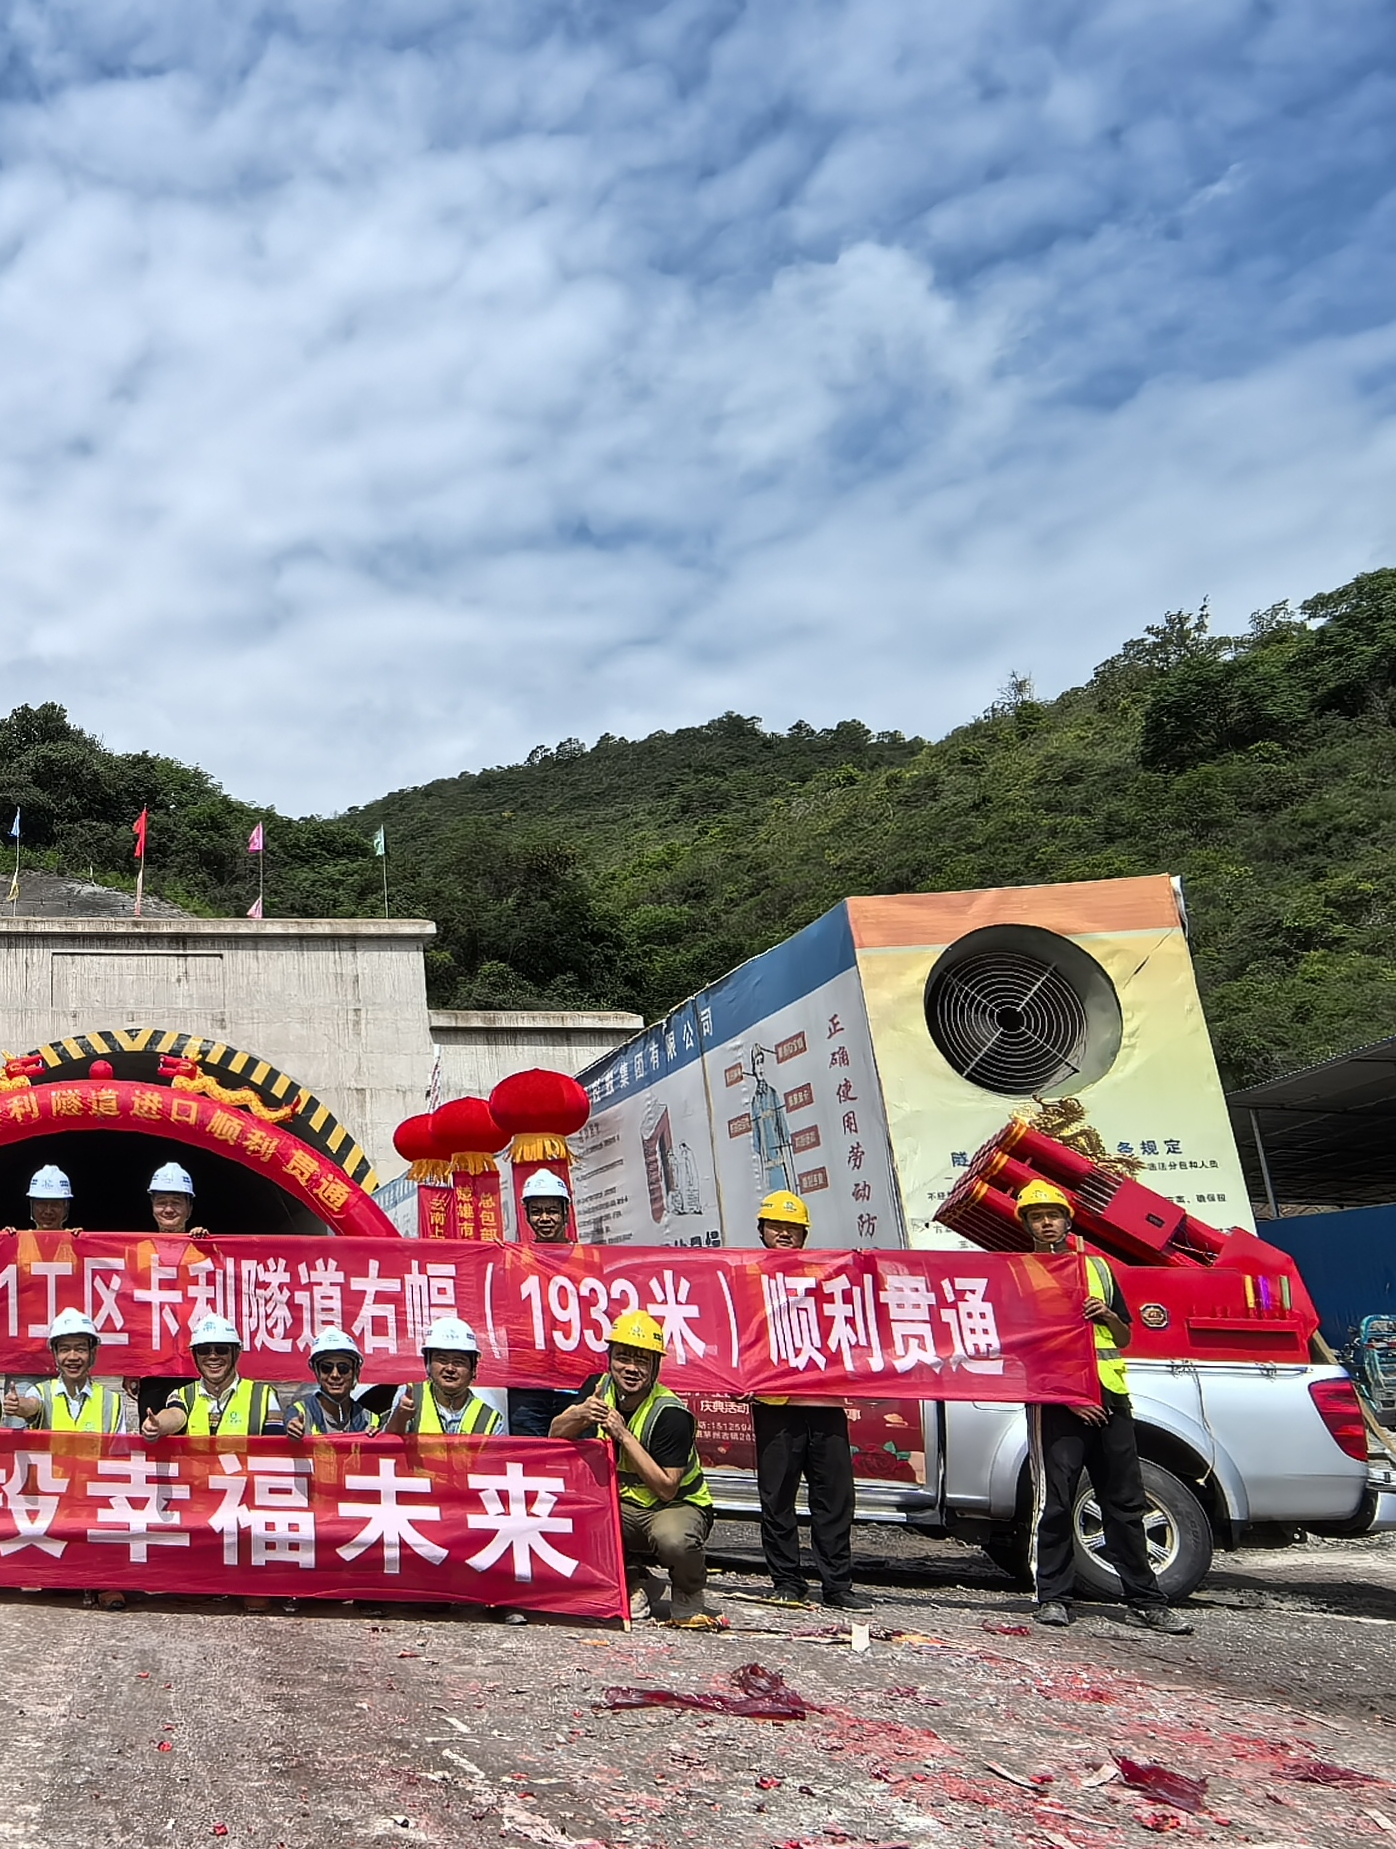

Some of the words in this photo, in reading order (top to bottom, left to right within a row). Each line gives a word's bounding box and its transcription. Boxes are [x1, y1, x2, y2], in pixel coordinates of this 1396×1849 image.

[826, 1013, 878, 1249] 正确使用劳动防
